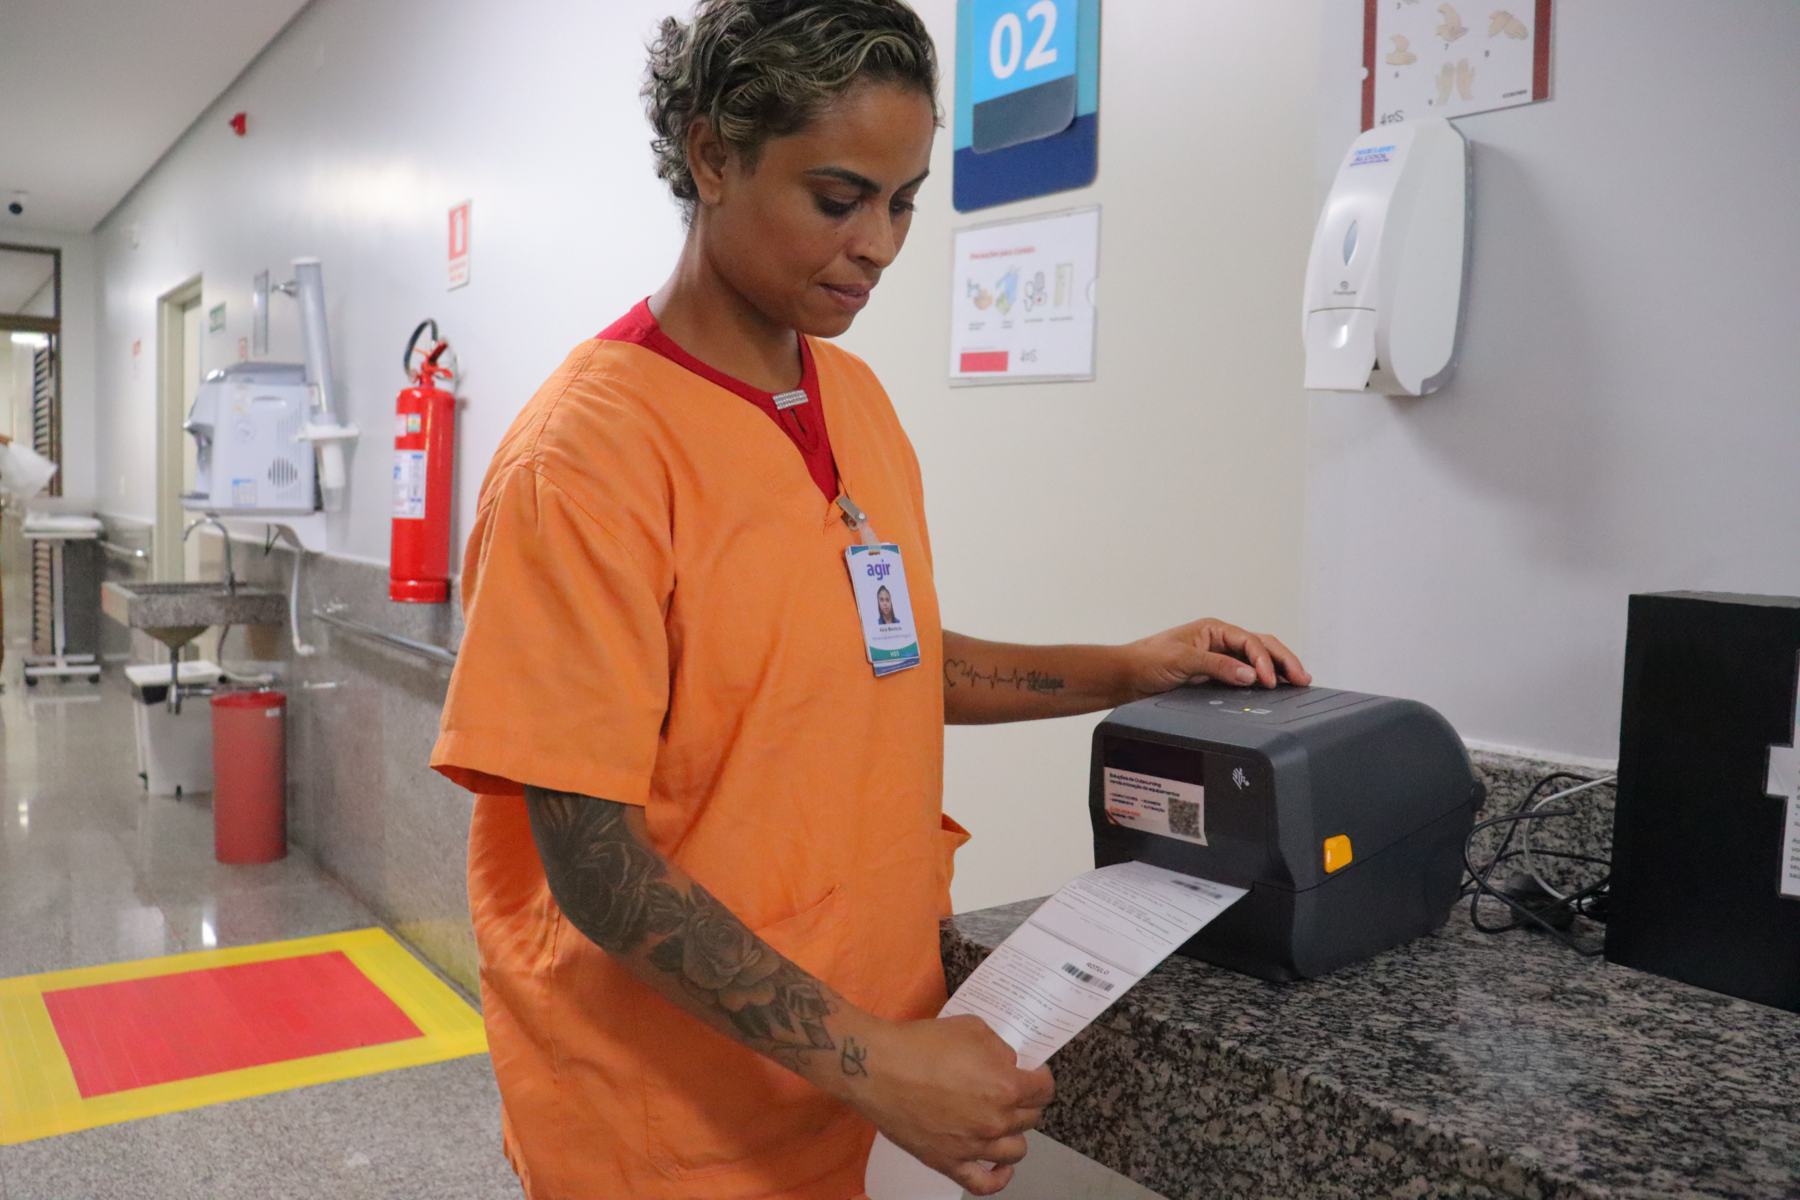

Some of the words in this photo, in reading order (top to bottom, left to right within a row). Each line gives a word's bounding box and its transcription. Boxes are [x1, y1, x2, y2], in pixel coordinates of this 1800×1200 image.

[989, 0, 1058, 79] 02
[1444, 43, 1449, 51] 7
[866, 559, 891, 580] agir
[1149, 787, 1180, 797] equipamentos
